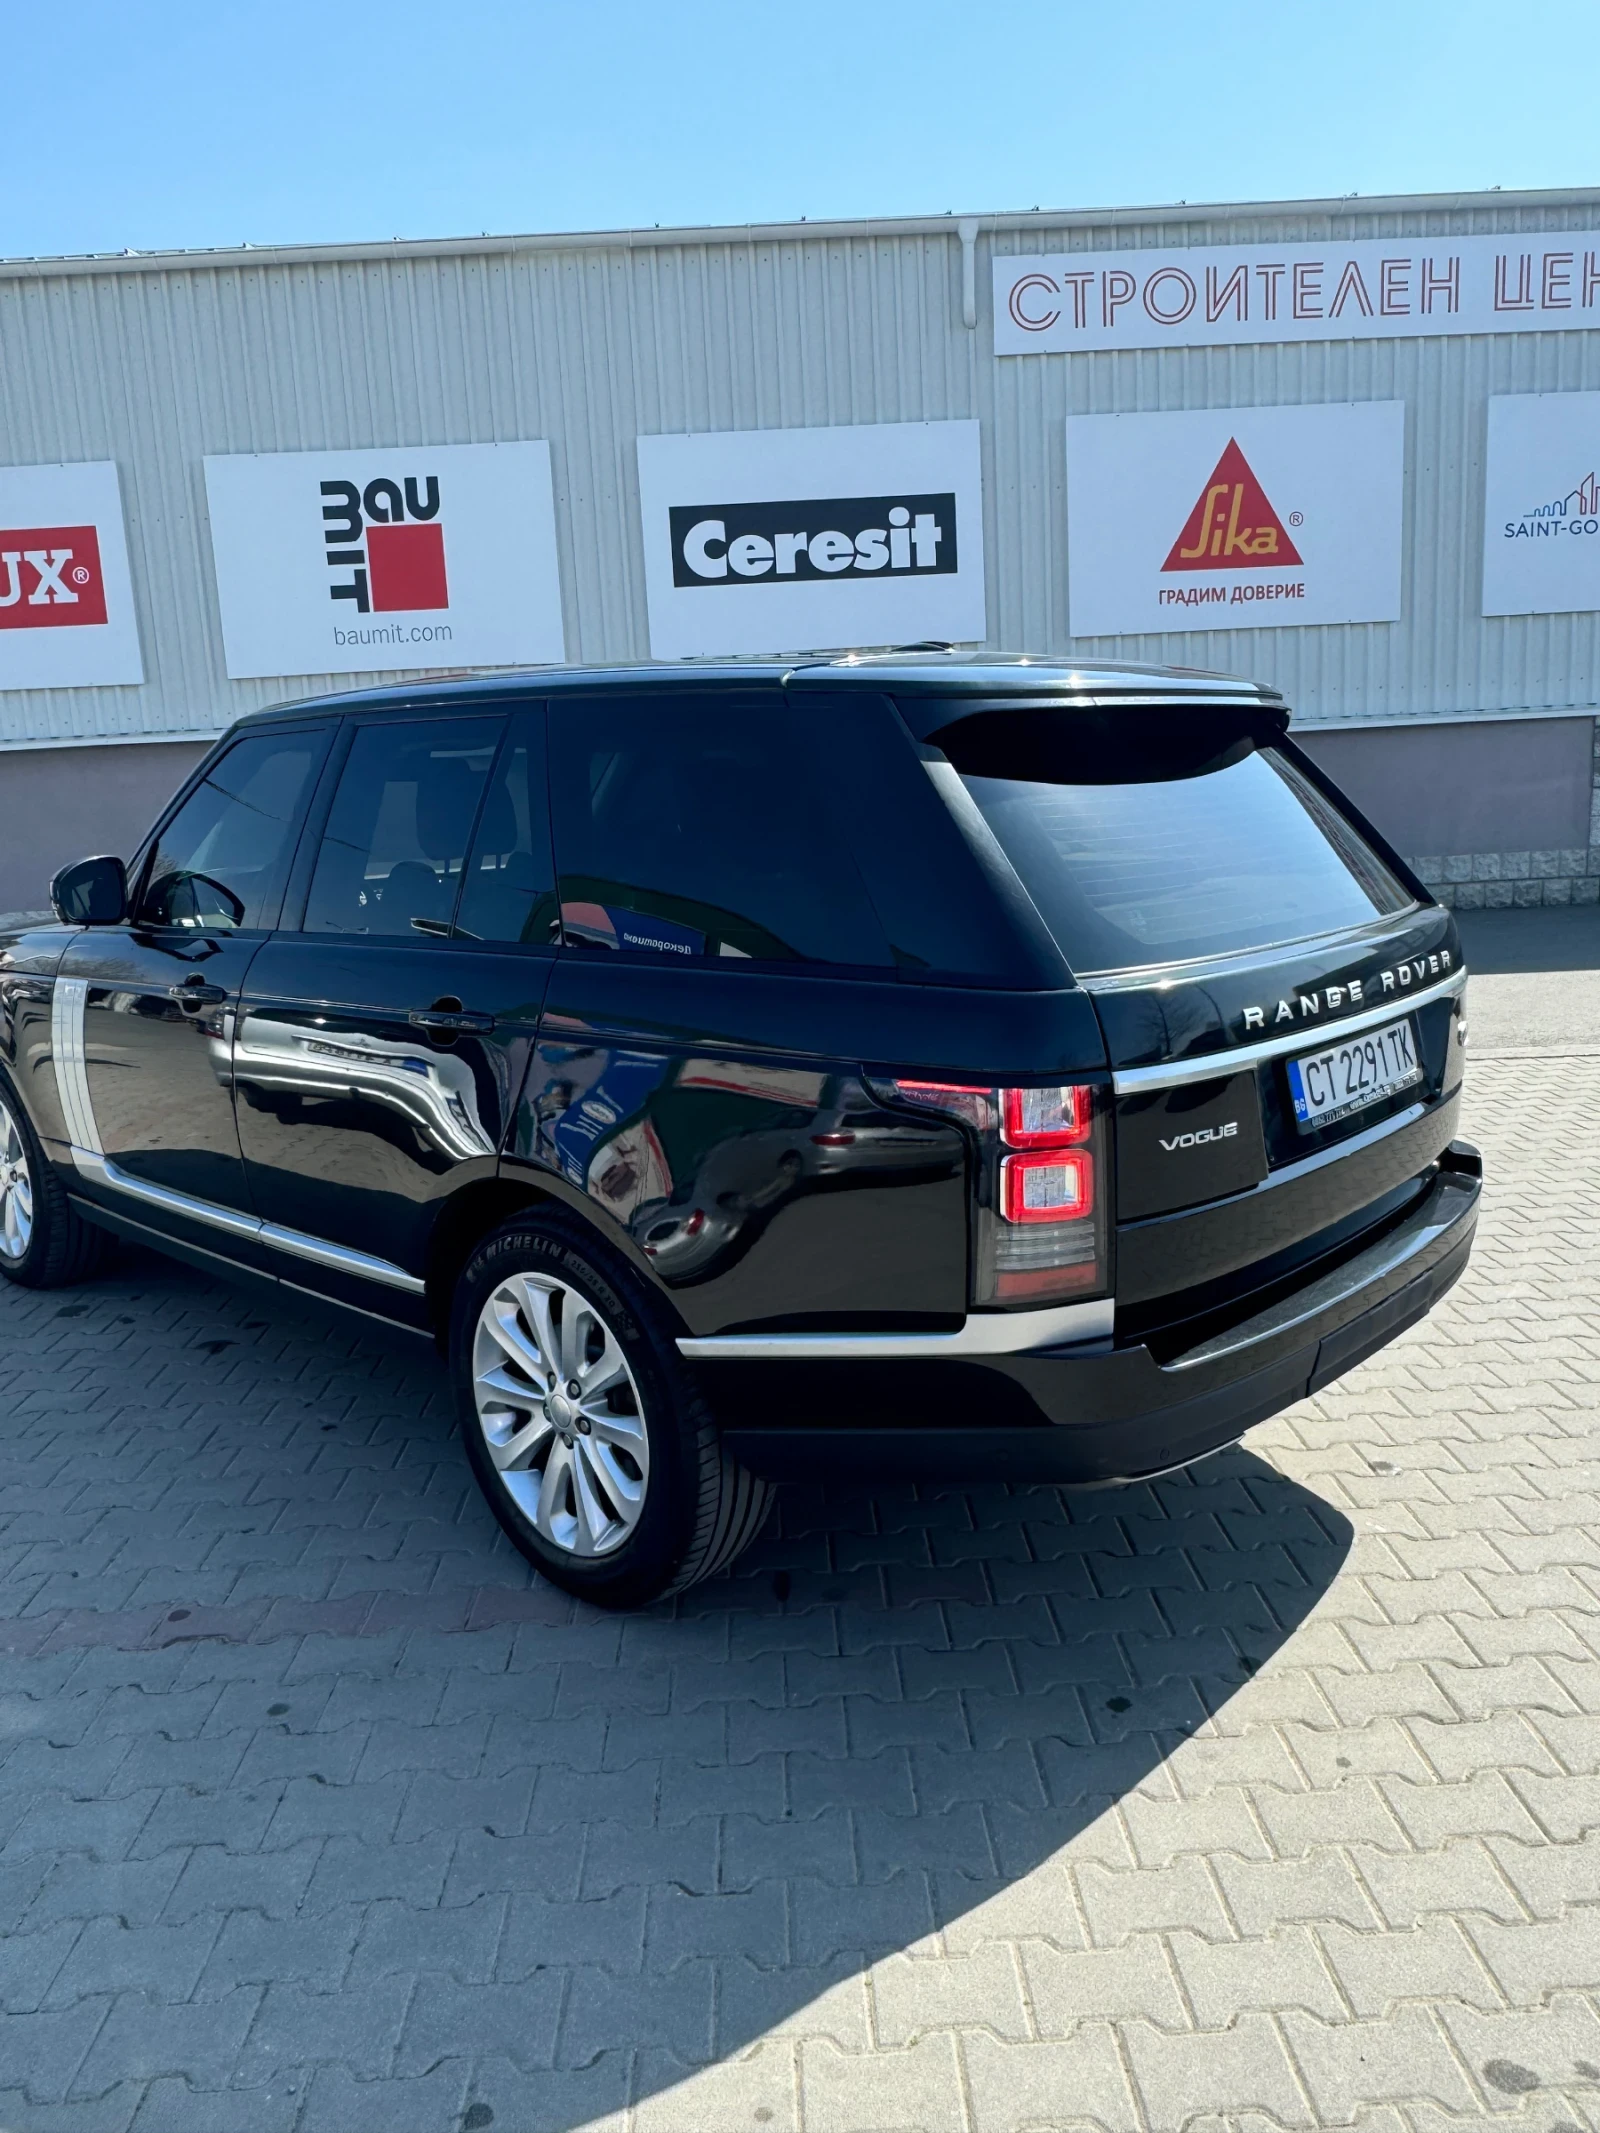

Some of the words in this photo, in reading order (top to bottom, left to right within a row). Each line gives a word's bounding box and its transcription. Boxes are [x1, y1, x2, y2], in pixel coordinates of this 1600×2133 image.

[1008, 257, 1460, 332] СТРОИТЕЛЕН
[1180, 483, 1279, 558] Sika
[1504, 519, 1599, 538] SAINT-GO
[683, 506, 942, 579] Ceresit
[1159, 587, 1227, 607] ГРАДИМ
[1230, 583, 1306, 605] ДОВЕРИЕ
[333, 624, 453, 646] baumit.com
[1243, 979, 1364, 1030] RANGE
[1380, 950, 1451, 993] ROVER
[1158, 1121, 1238, 1151] VOGUE
[486, 1236, 562, 1259] MICHELIN
